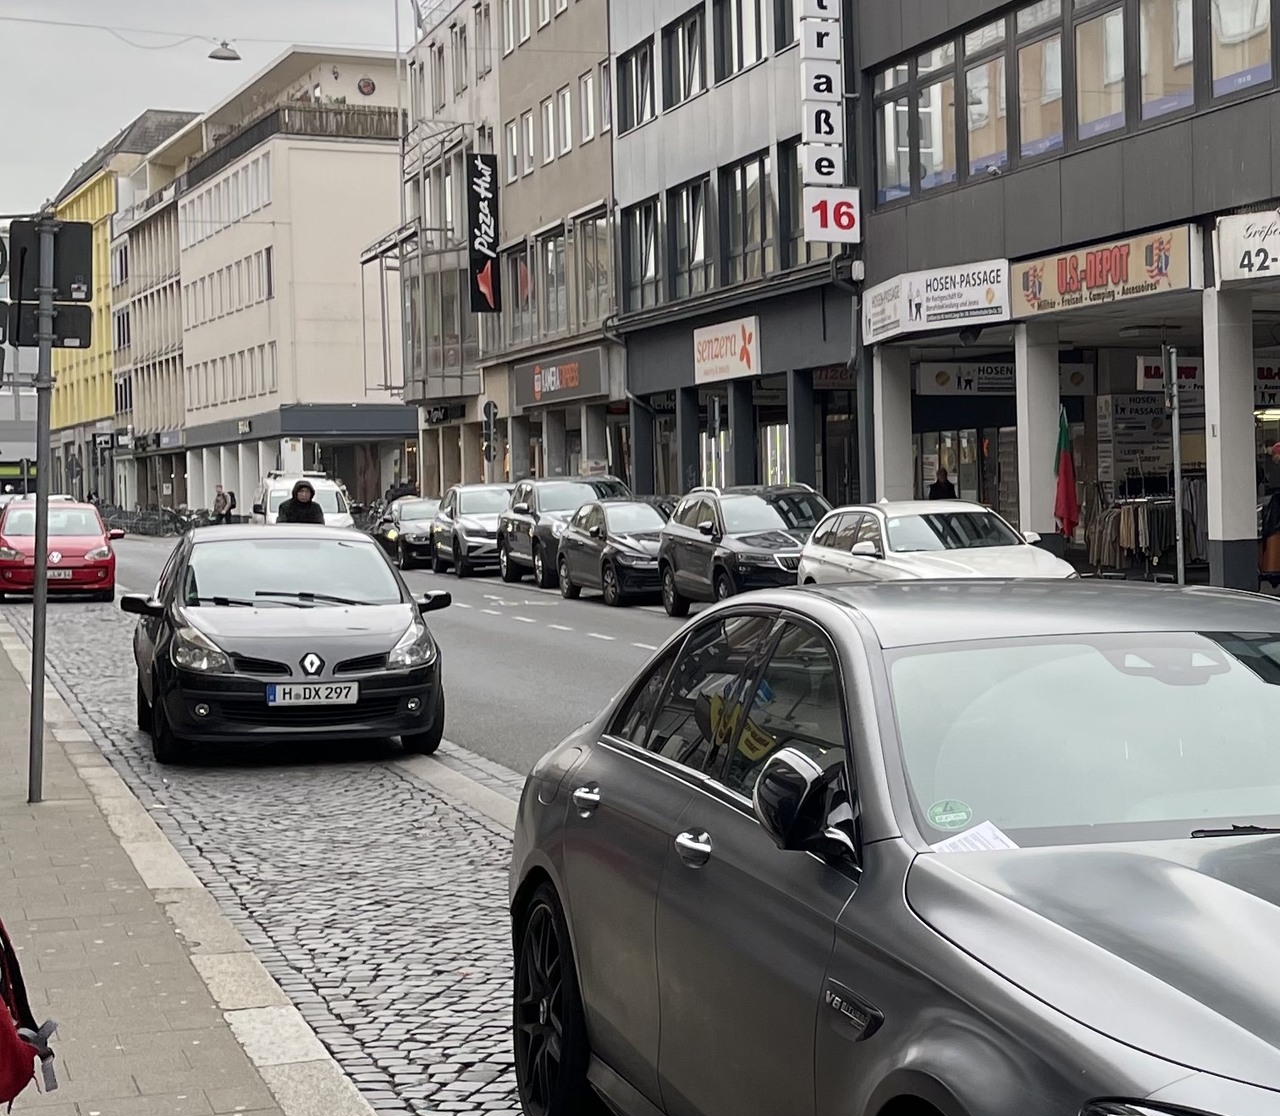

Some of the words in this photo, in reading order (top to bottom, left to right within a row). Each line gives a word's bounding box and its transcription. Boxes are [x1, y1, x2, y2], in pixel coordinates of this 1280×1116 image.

[472, 154, 494, 199] Hut
[474, 200, 498, 259] Pizza
[811, 199, 856, 231] 16
[925, 268, 1002, 294] HOSEN-PASSAGE
[1056, 243, 1131, 295] U.S.-DEPOT
[1088, 288, 1115, 303] Camping
[1120, 282, 1158, 296] Accessoires
[696, 333, 737, 365] senzera
[282, 687, 292, 701] H
[302, 687, 322, 701] DX
[325, 686, 352, 700] 297
[825, 989, 843, 1010] V8
